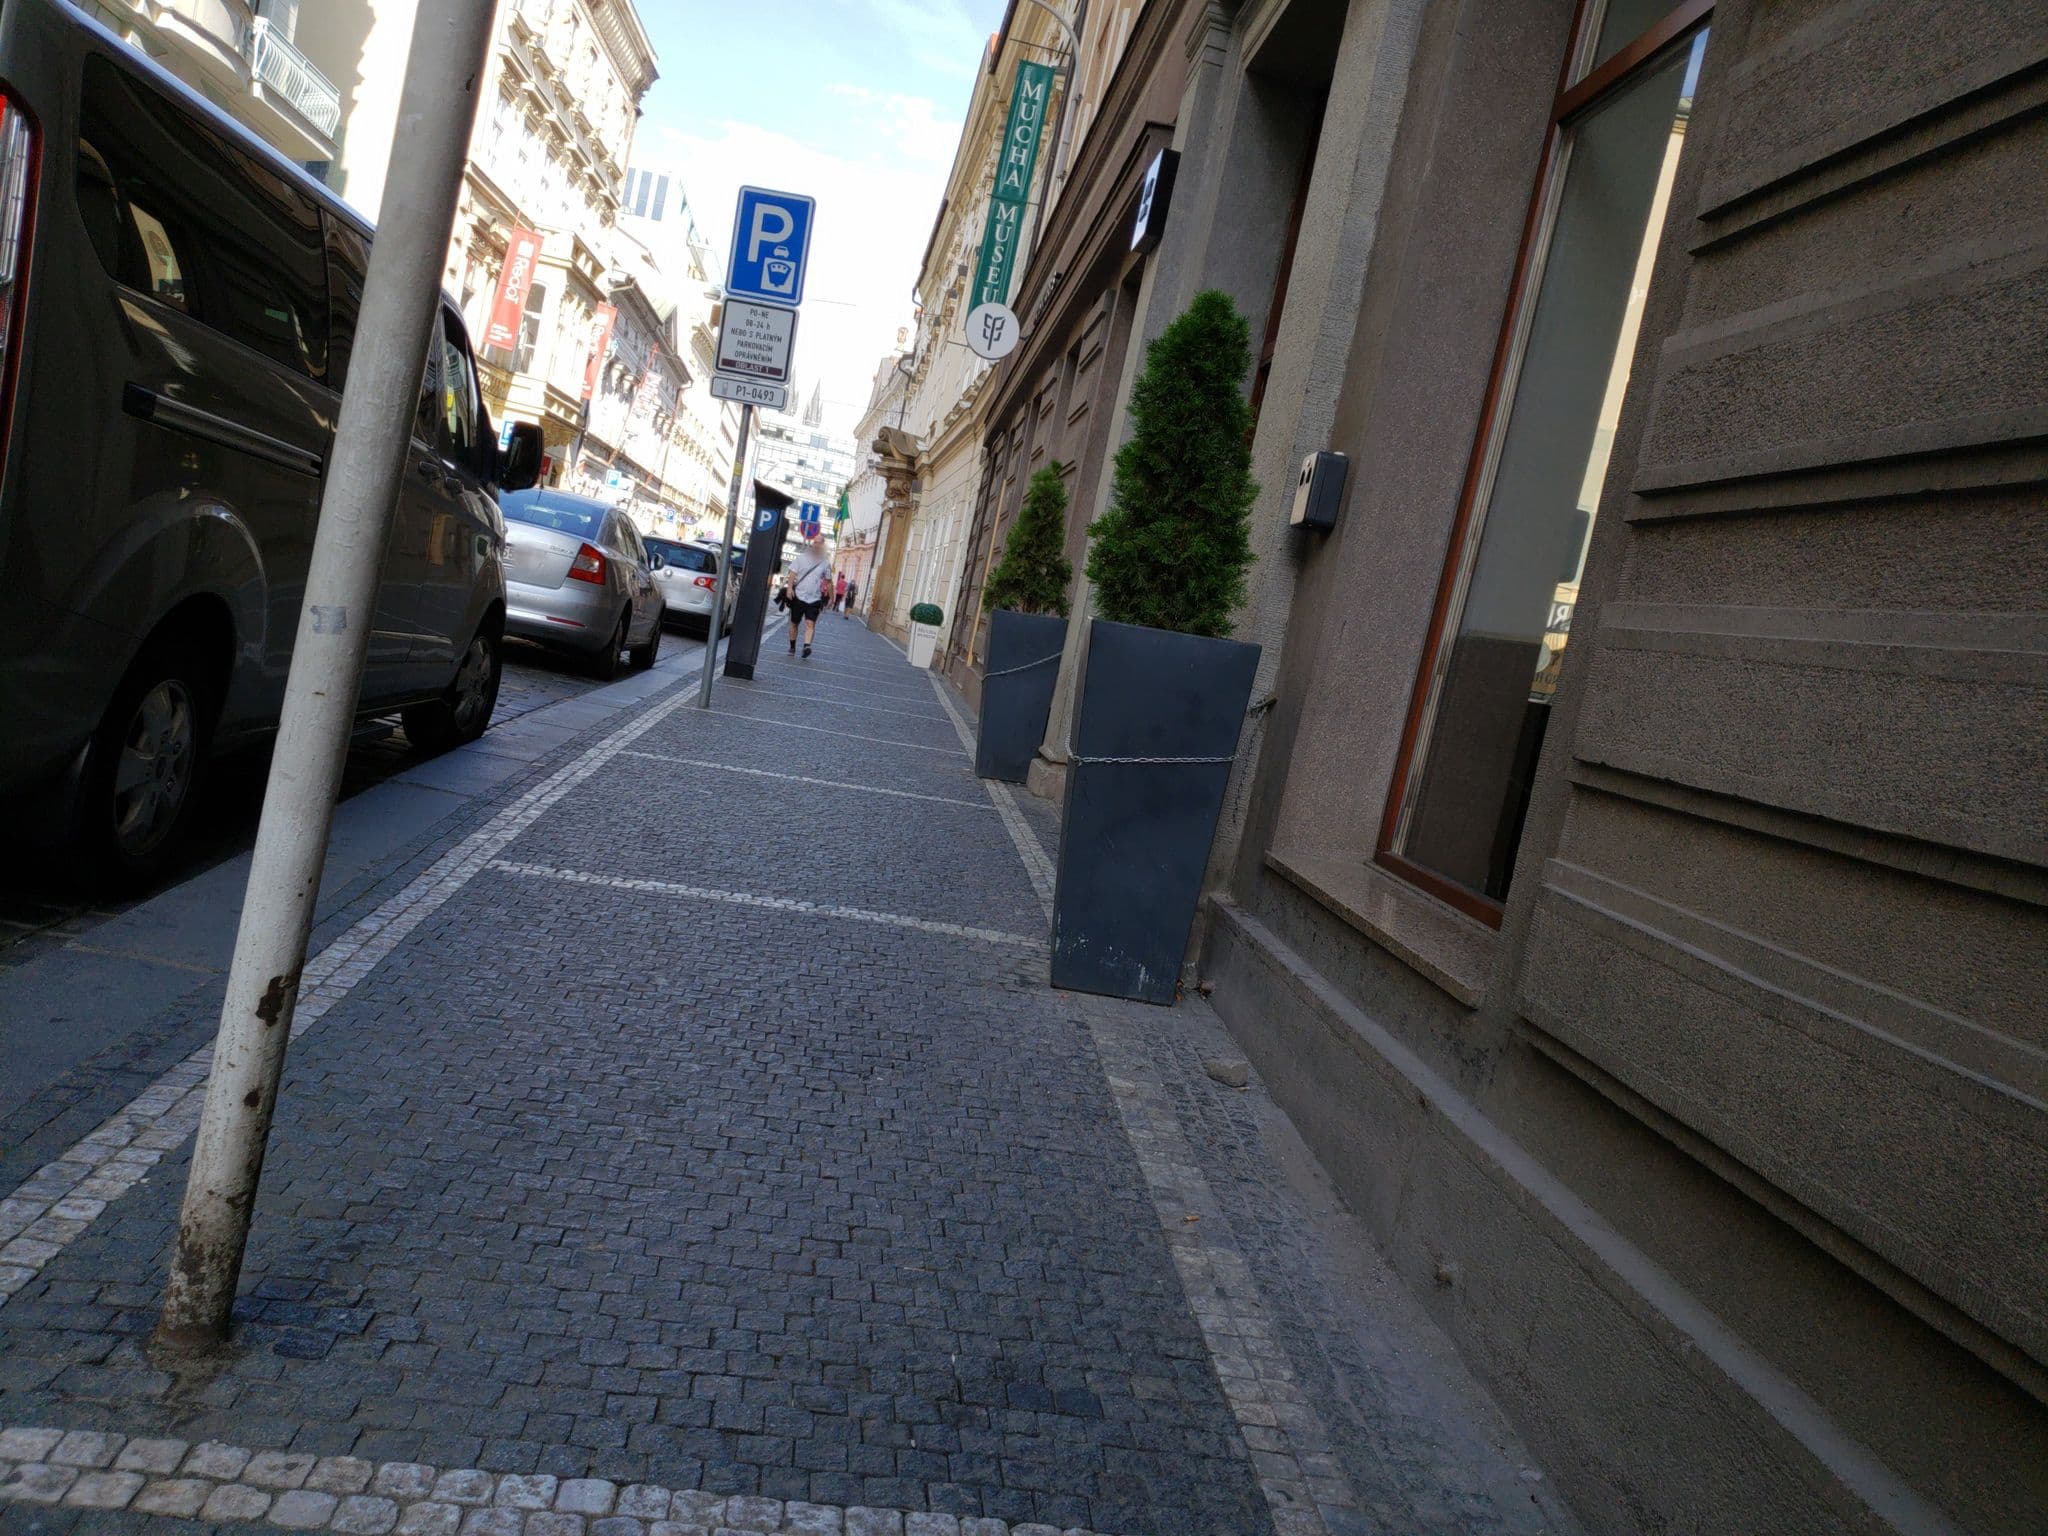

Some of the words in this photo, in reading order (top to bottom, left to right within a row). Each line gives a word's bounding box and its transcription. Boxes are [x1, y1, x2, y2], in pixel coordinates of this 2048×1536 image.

[1005, 80, 1043, 187] MUCHA
[747, 202, 794, 264] P
[981, 202, 1019, 304] MUSEU
[730, 327, 747, 337] NEBO
[749, 330, 754, 338] S
[735, 361, 761, 373] OBLAST
[735, 385, 775, 402] P1-0493
[759, 510, 772, 527] P
